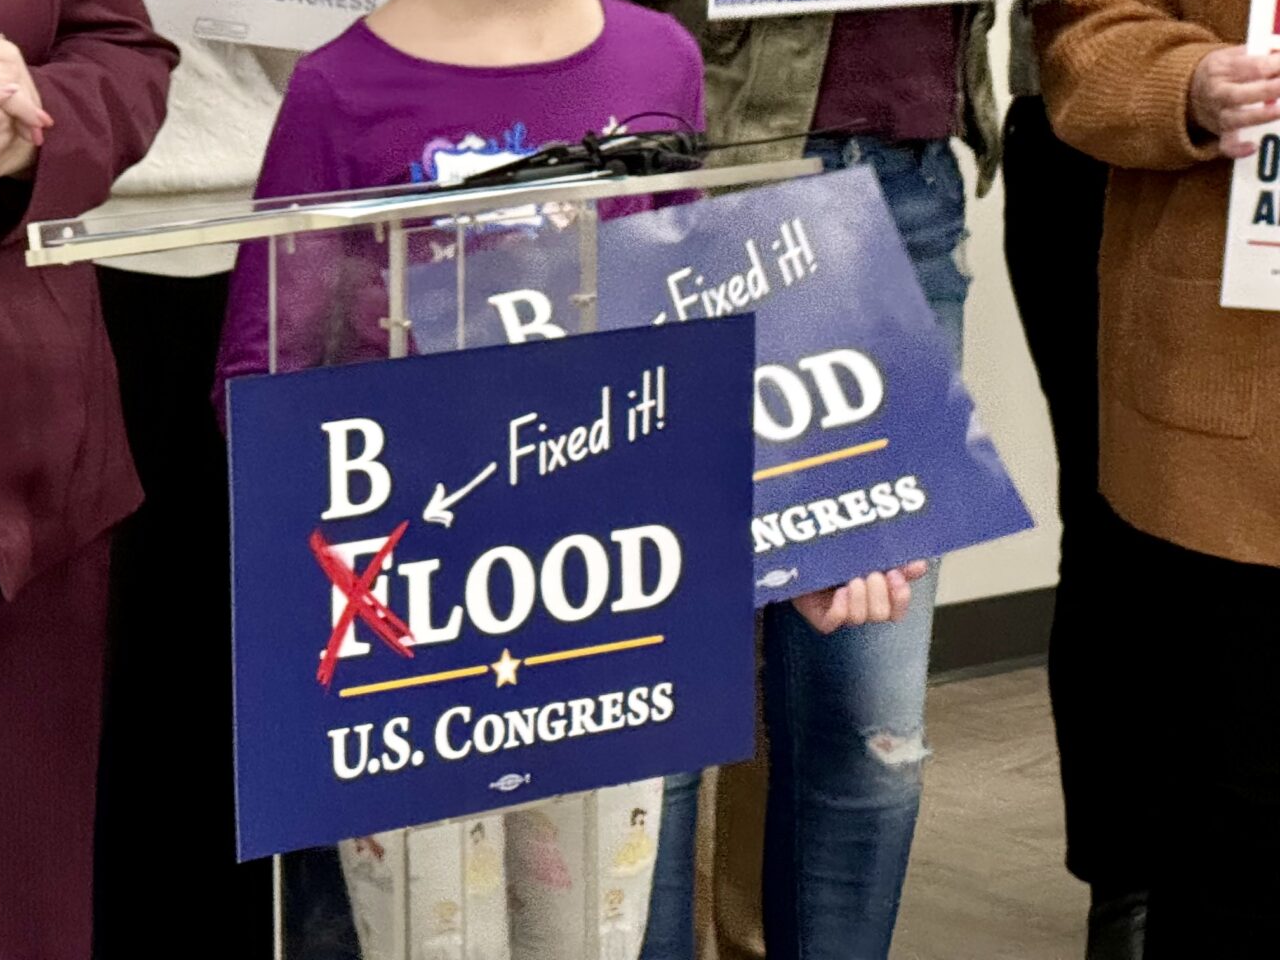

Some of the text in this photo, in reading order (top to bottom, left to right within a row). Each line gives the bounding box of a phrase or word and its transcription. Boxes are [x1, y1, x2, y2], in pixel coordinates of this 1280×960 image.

[667, 239, 769, 322] Fixed
[772, 218, 818, 286] it!
[320, 366, 666, 521] B Fixed it!
[327, 682, 675, 781] U.S. CONGRESS
